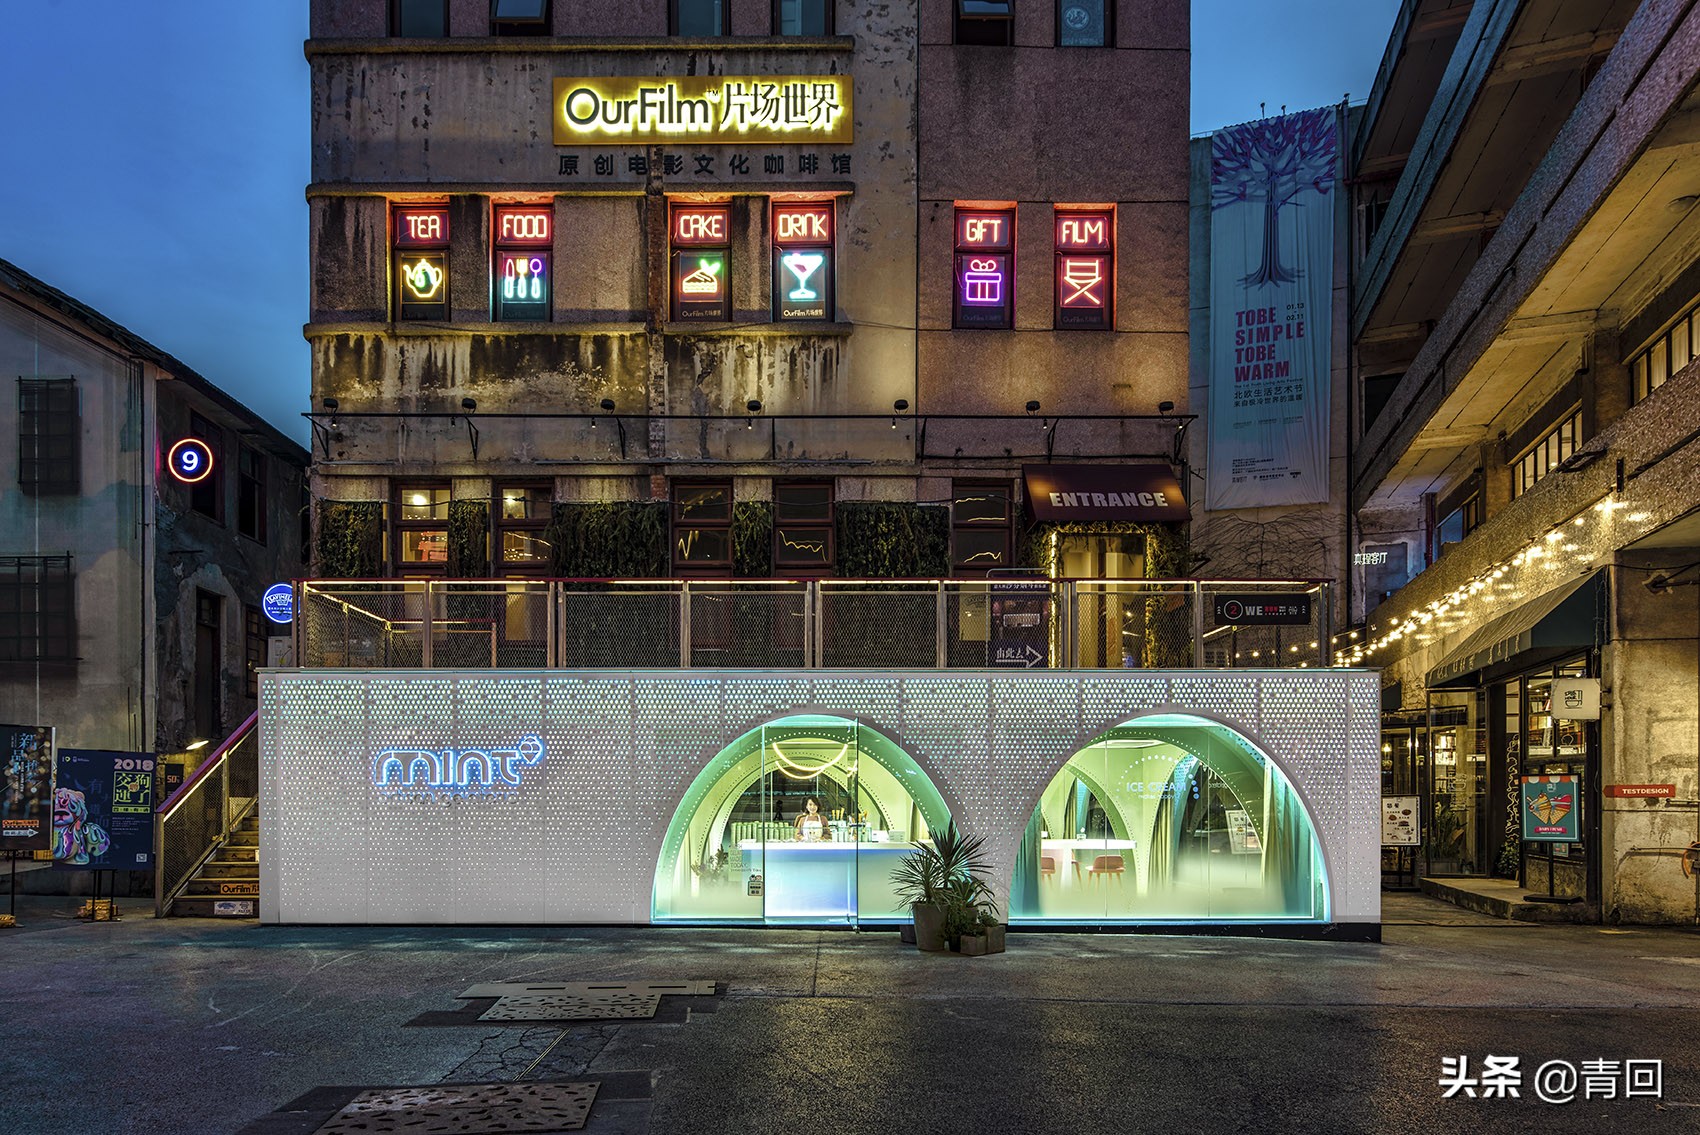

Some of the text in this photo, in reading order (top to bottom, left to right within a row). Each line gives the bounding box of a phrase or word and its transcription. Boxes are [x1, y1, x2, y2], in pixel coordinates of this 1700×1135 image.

[565, 84, 708, 125] OurFilm
[721, 83, 841, 126] 片场世界
[558, 154, 851, 175] 原创电影文化咖啡馆
[406, 215, 441, 239] TEA
[503, 215, 547, 238] FOOD
[680, 214, 723, 238] CAKE
[778, 213, 827, 237] DRINK
[966, 219, 1002, 242] GIFT
[1062, 221, 1103, 244] FILM
[1236, 307, 1276, 327] TOBE
[1235, 322, 1304, 346] SIMPLE
[1235, 344, 1275, 364] TOBE
[1234, 361, 1289, 382] WARM
[182, 451, 198, 471] 9
[1049, 492, 1168, 507] ENTRANCE
[1230, 605, 1238, 614] 2
[1245, 606, 1263, 616] WE
[114, 758, 154, 771] 2018
[375, 751, 520, 785] mint
